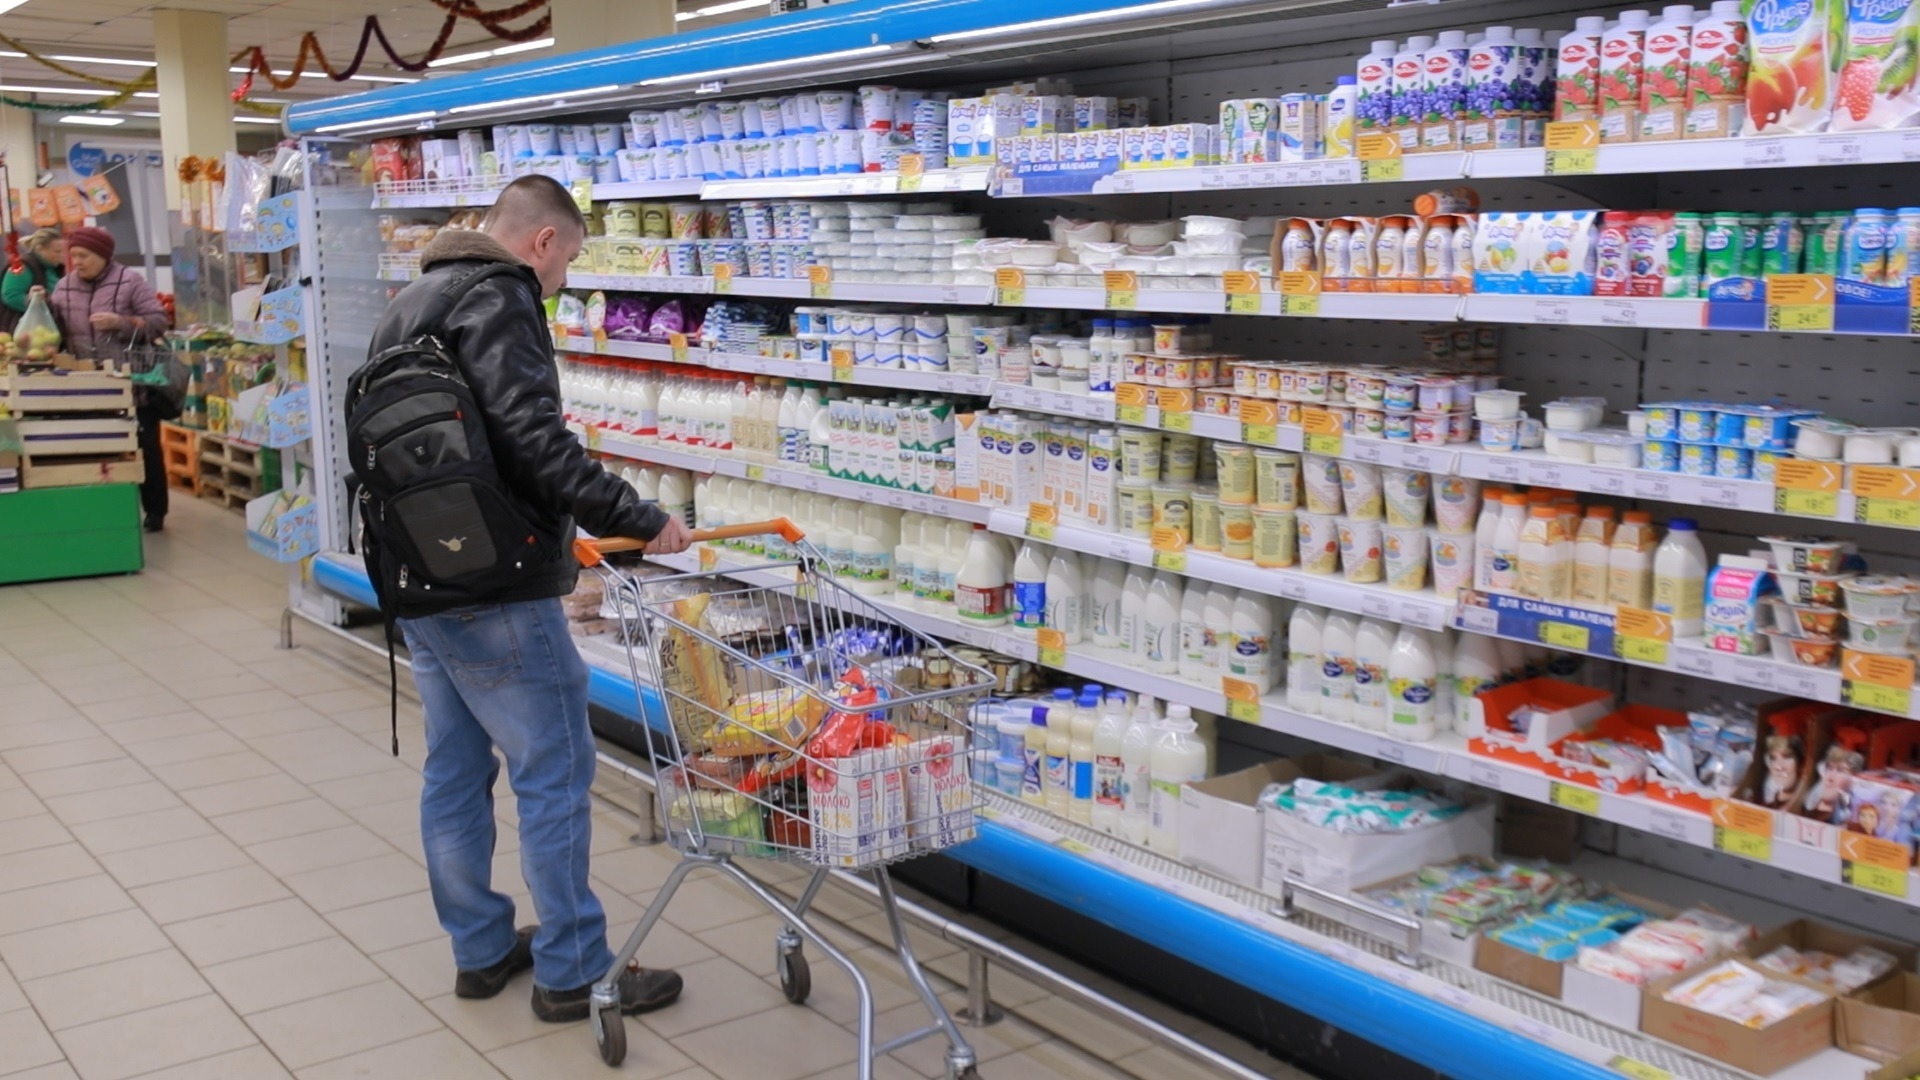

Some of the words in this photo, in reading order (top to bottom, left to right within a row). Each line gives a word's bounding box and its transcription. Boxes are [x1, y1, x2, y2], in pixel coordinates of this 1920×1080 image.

[1033, 163, 1057, 172] САМЫХ
[1836, 283, 1872, 298] ОВОЕ!
[1497, 597, 1519, 610] ДЛЯ
[1523, 600, 1564, 618] САМЫХ
[1569, 610, 1616, 628] МАЛЕНЬ
[934, 774, 967, 792] МОЛОКО
[813, 795, 851, 809] МОЛОКО
